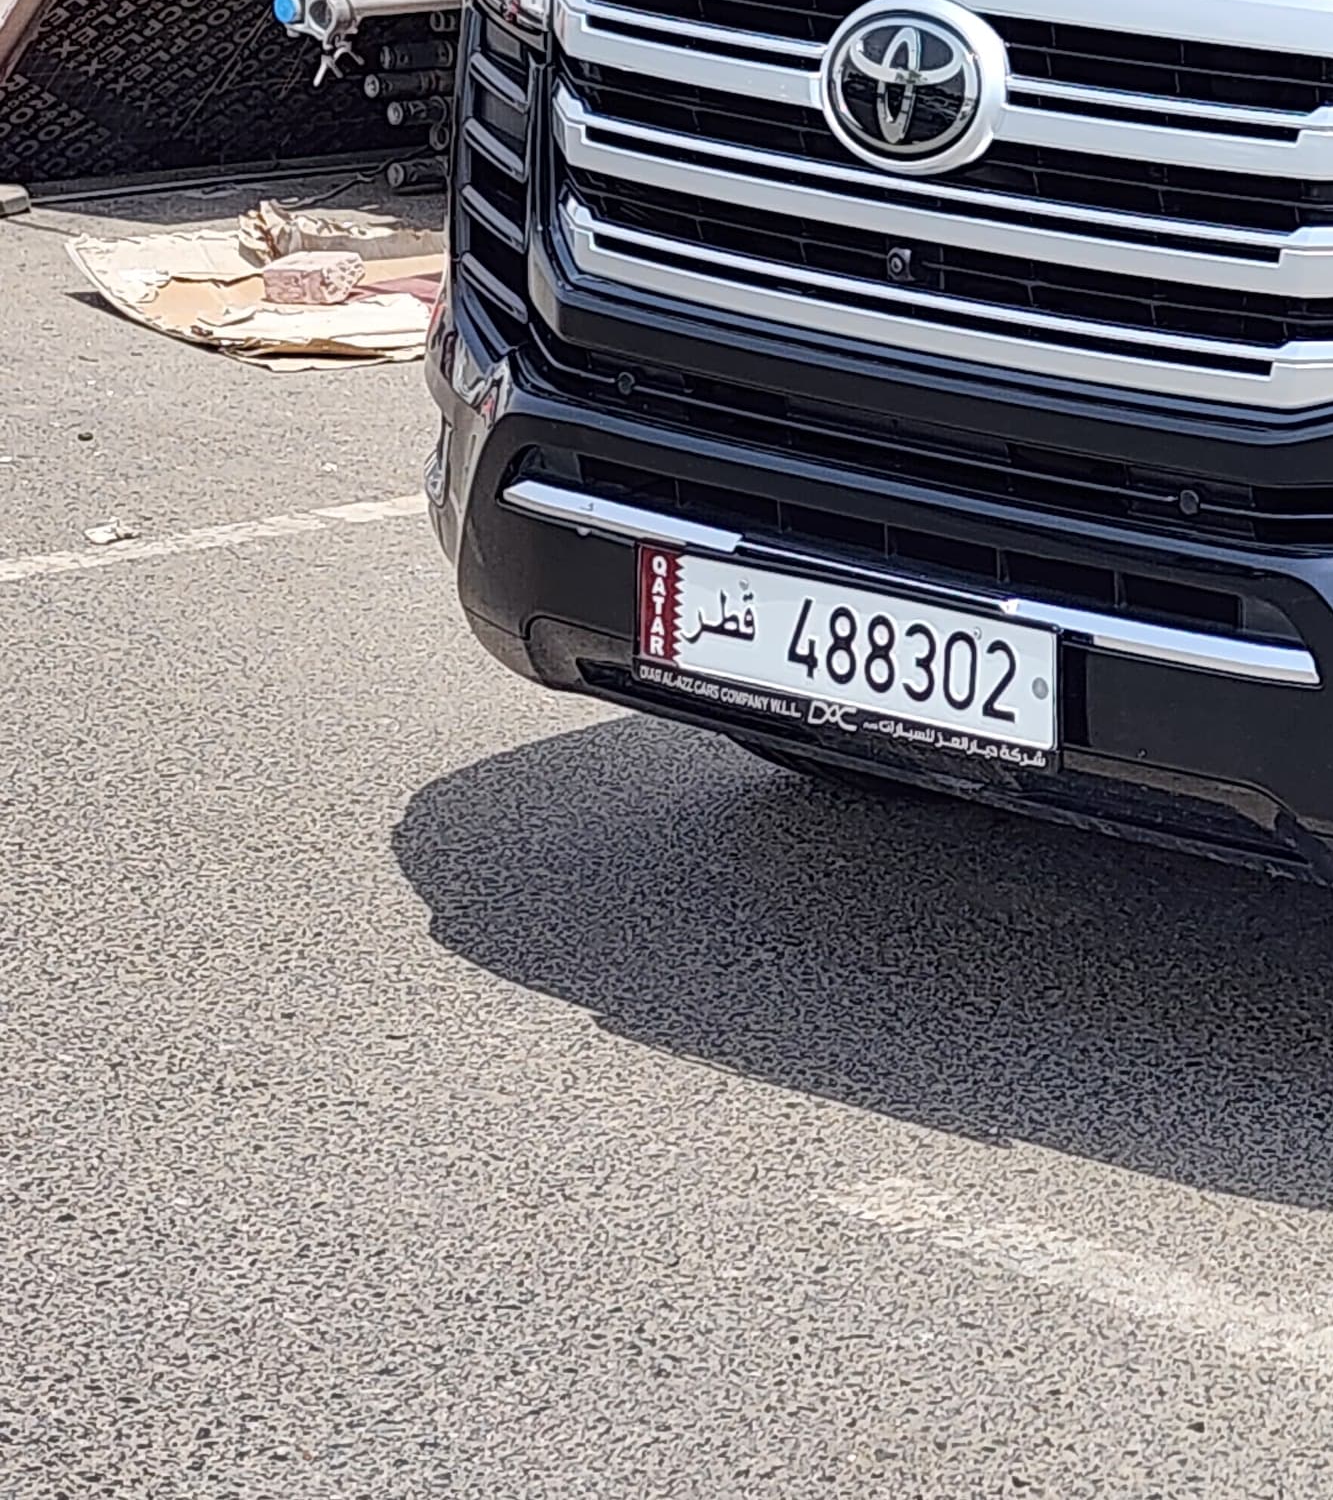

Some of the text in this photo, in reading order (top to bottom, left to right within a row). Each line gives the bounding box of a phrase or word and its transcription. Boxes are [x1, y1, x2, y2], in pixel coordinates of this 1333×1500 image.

[650, 555, 665, 657] QATAR
[683, 590, 757, 643] قطر
[694, 680, 720, 701] CARS
[720, 687, 771, 713] COMPANY
[786, 596, 1017, 724] 488302
